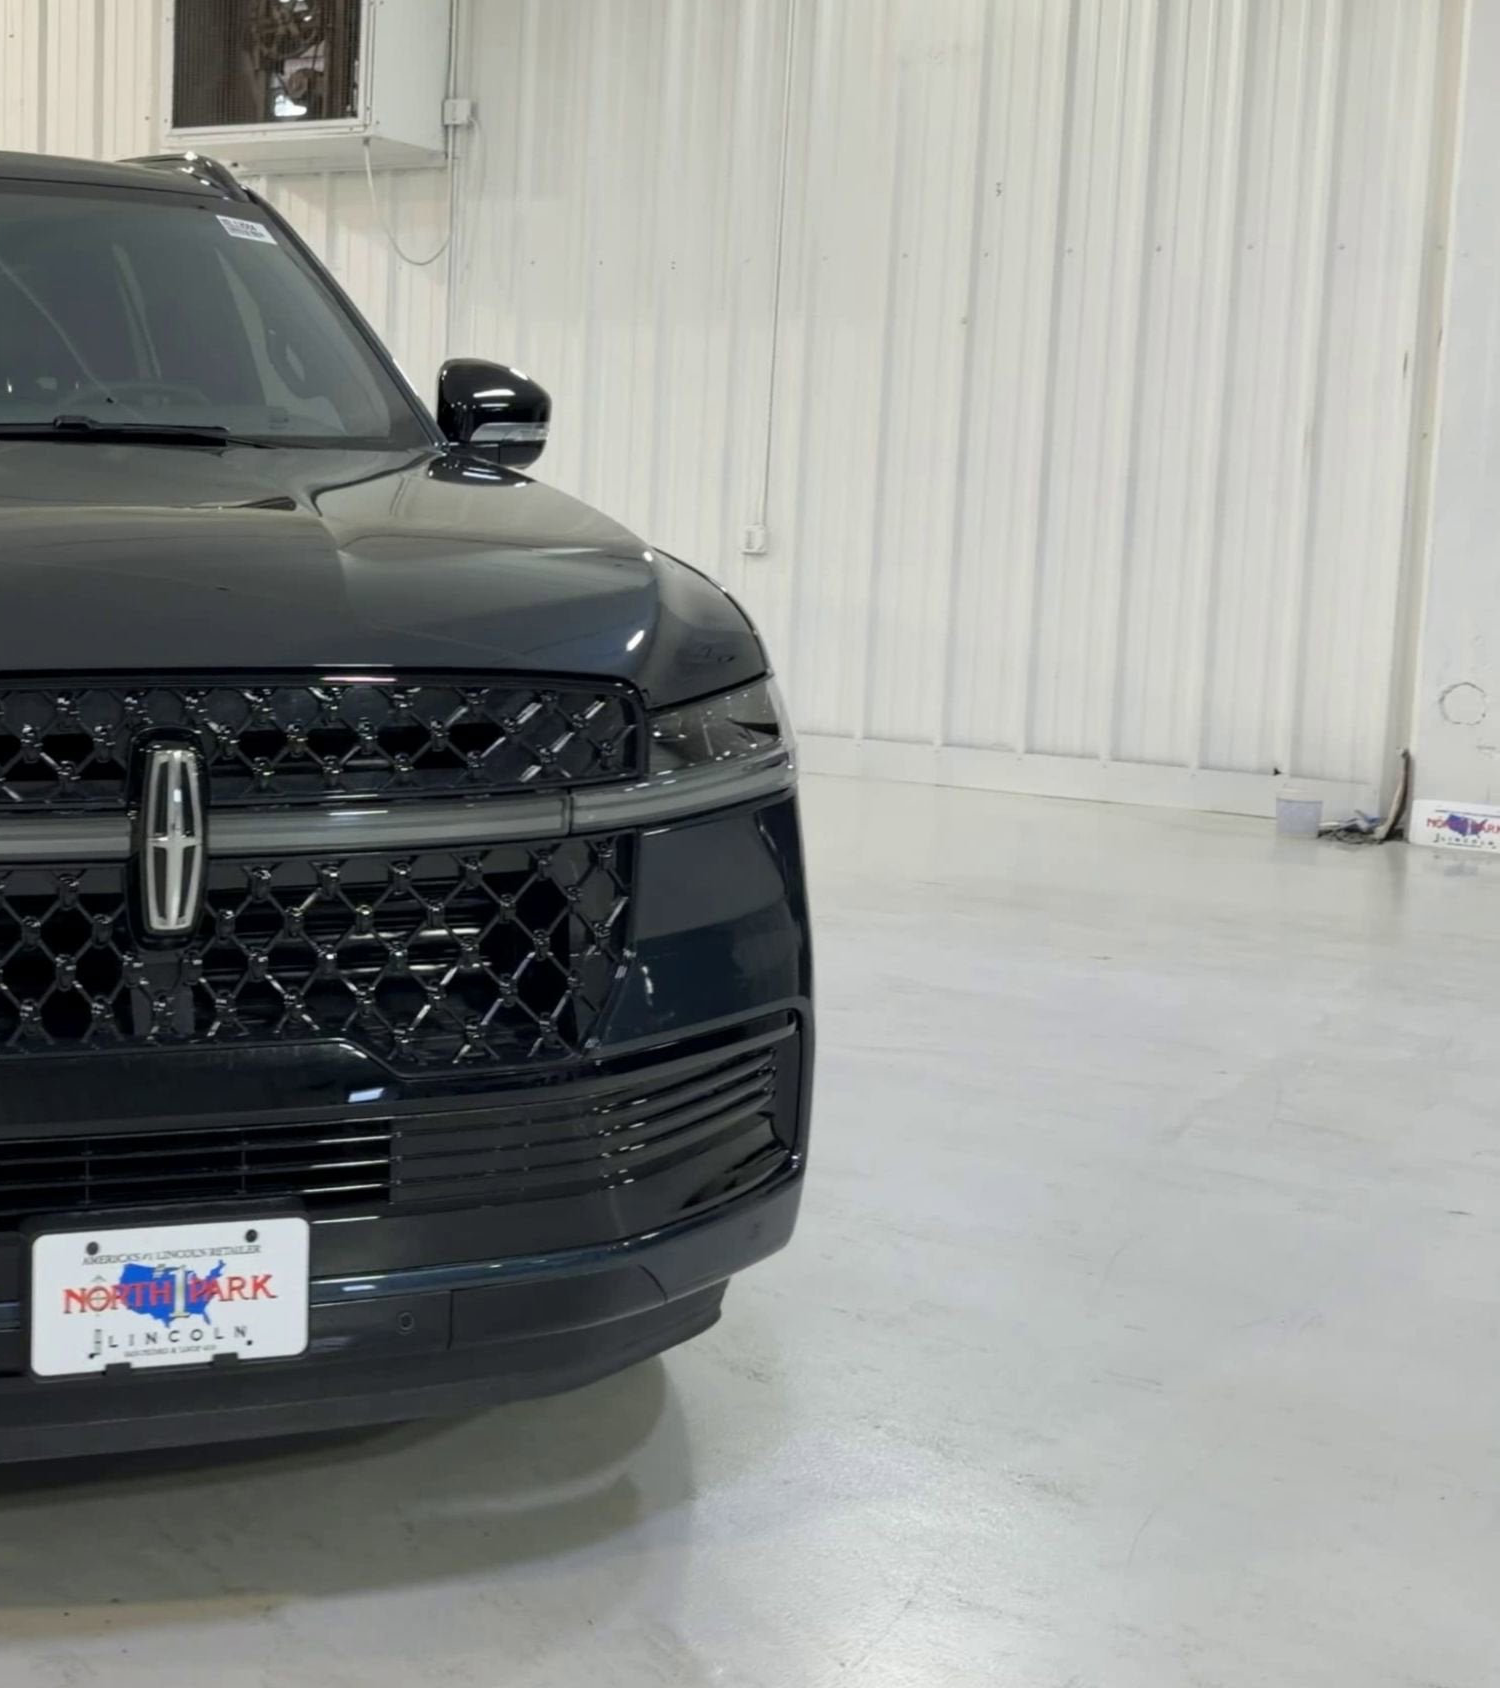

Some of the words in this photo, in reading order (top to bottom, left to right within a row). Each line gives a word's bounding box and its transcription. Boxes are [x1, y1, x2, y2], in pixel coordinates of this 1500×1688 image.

[157, 1247, 206, 1260] LINCOLN
[208, 1244, 261, 1257] RETAILER
[63, 1280, 171, 1314] NORTH
[190, 1274, 278, 1303] PARK
[108, 1326, 247, 1348] LINCOLN
